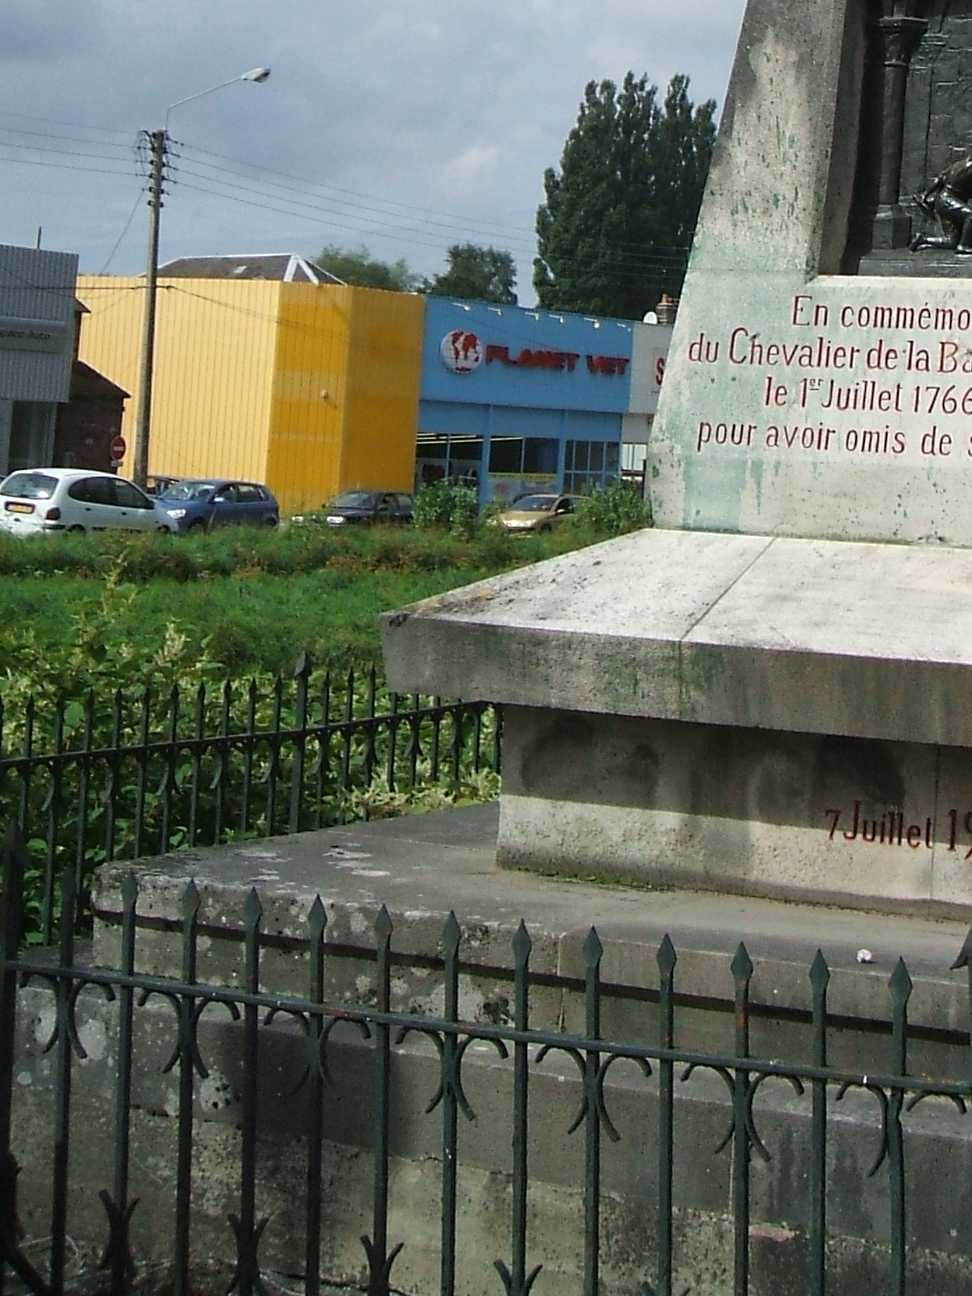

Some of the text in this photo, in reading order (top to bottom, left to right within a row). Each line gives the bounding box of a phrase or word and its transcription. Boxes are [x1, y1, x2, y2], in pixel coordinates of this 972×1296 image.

[792, 295, 829, 327] En
[688, 332, 720, 364] du
[728, 327, 861, 370] Chevalier
[866, 339, 898, 370] de
[906, 340, 931, 373] la
[764, 376, 788, 407] le
[821, 378, 903, 412] Juillet
[697, 421, 758, 453] pour
[765, 421, 837, 452] avoir
[845, 425, 906, 454] omis
[920, 425, 952, 456] de
[824, 809, 842, 841] 7
[842, 800, 935, 850] Juillet
